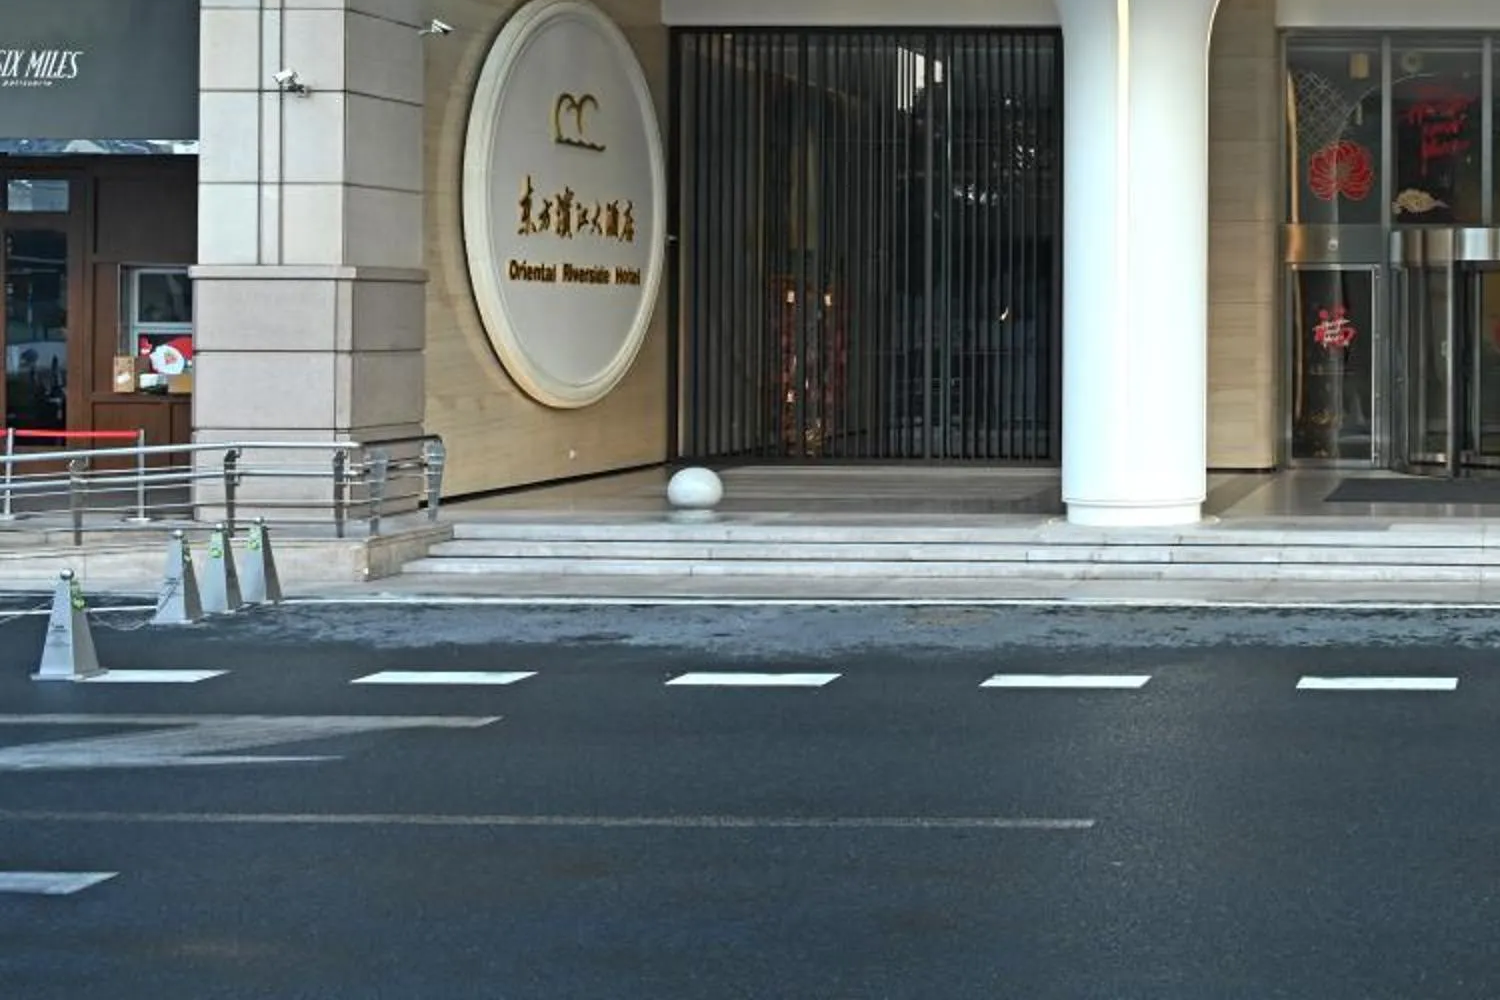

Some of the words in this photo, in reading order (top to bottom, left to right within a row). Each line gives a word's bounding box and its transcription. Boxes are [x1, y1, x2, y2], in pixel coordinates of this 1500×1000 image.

[25, 50, 84, 79] MILES
[509, 259, 556, 282] Oriental
[562, 263, 610, 284] Riverside
[615, 266, 640, 286] Hotel
